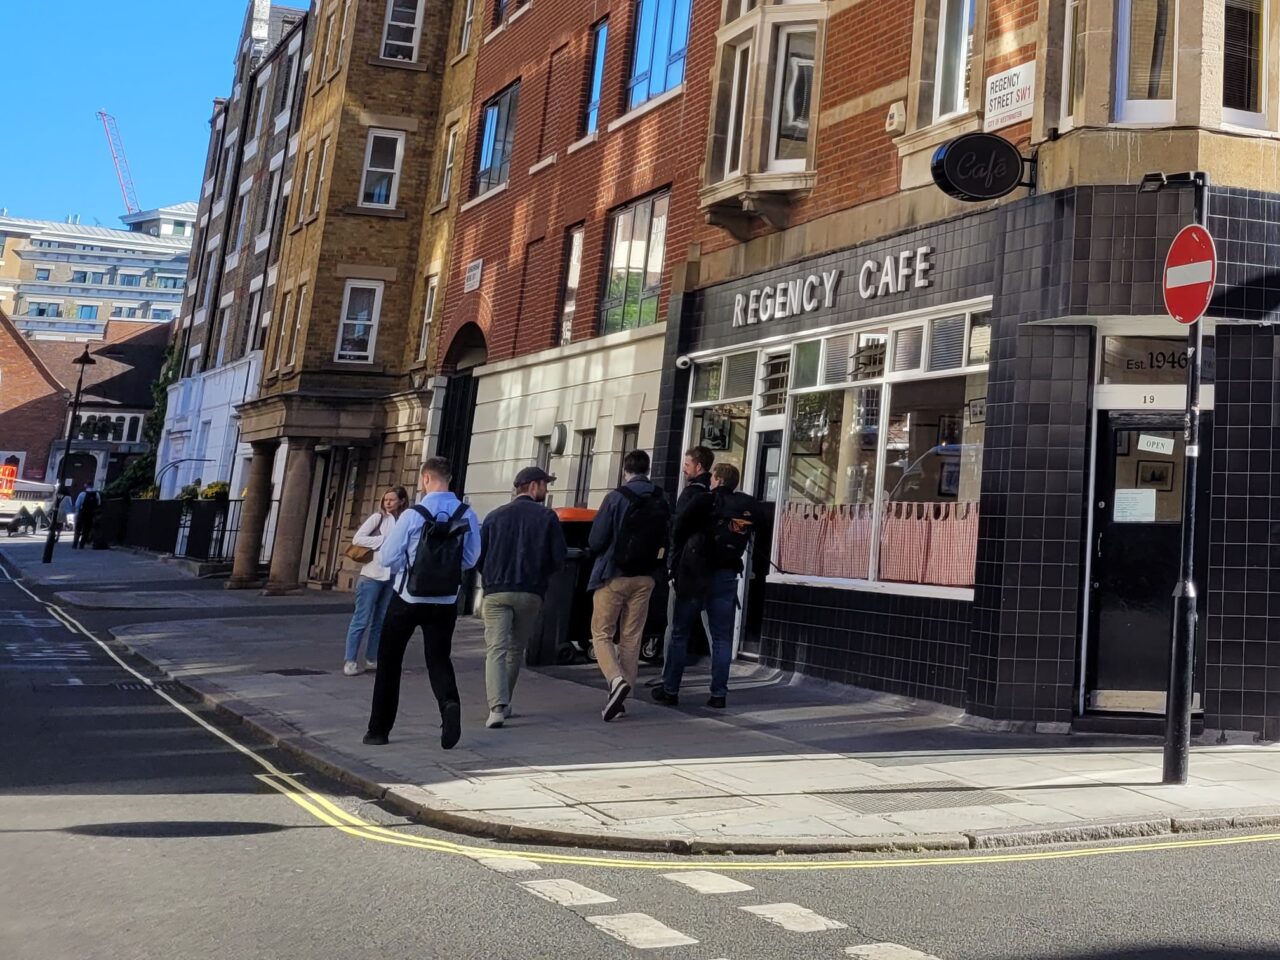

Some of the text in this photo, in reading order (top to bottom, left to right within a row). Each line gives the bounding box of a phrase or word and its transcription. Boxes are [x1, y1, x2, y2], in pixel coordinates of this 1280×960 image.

[990, 71, 1021, 95] REGENCY
[988, 84, 1031, 113] STREET SW1
[732, 245, 932, 327] REGENCY CAFE
[1148, 351, 1188, 369] 1946
[1143, 395, 1155, 404] 19
[1146, 440, 1166, 451] OPEN
